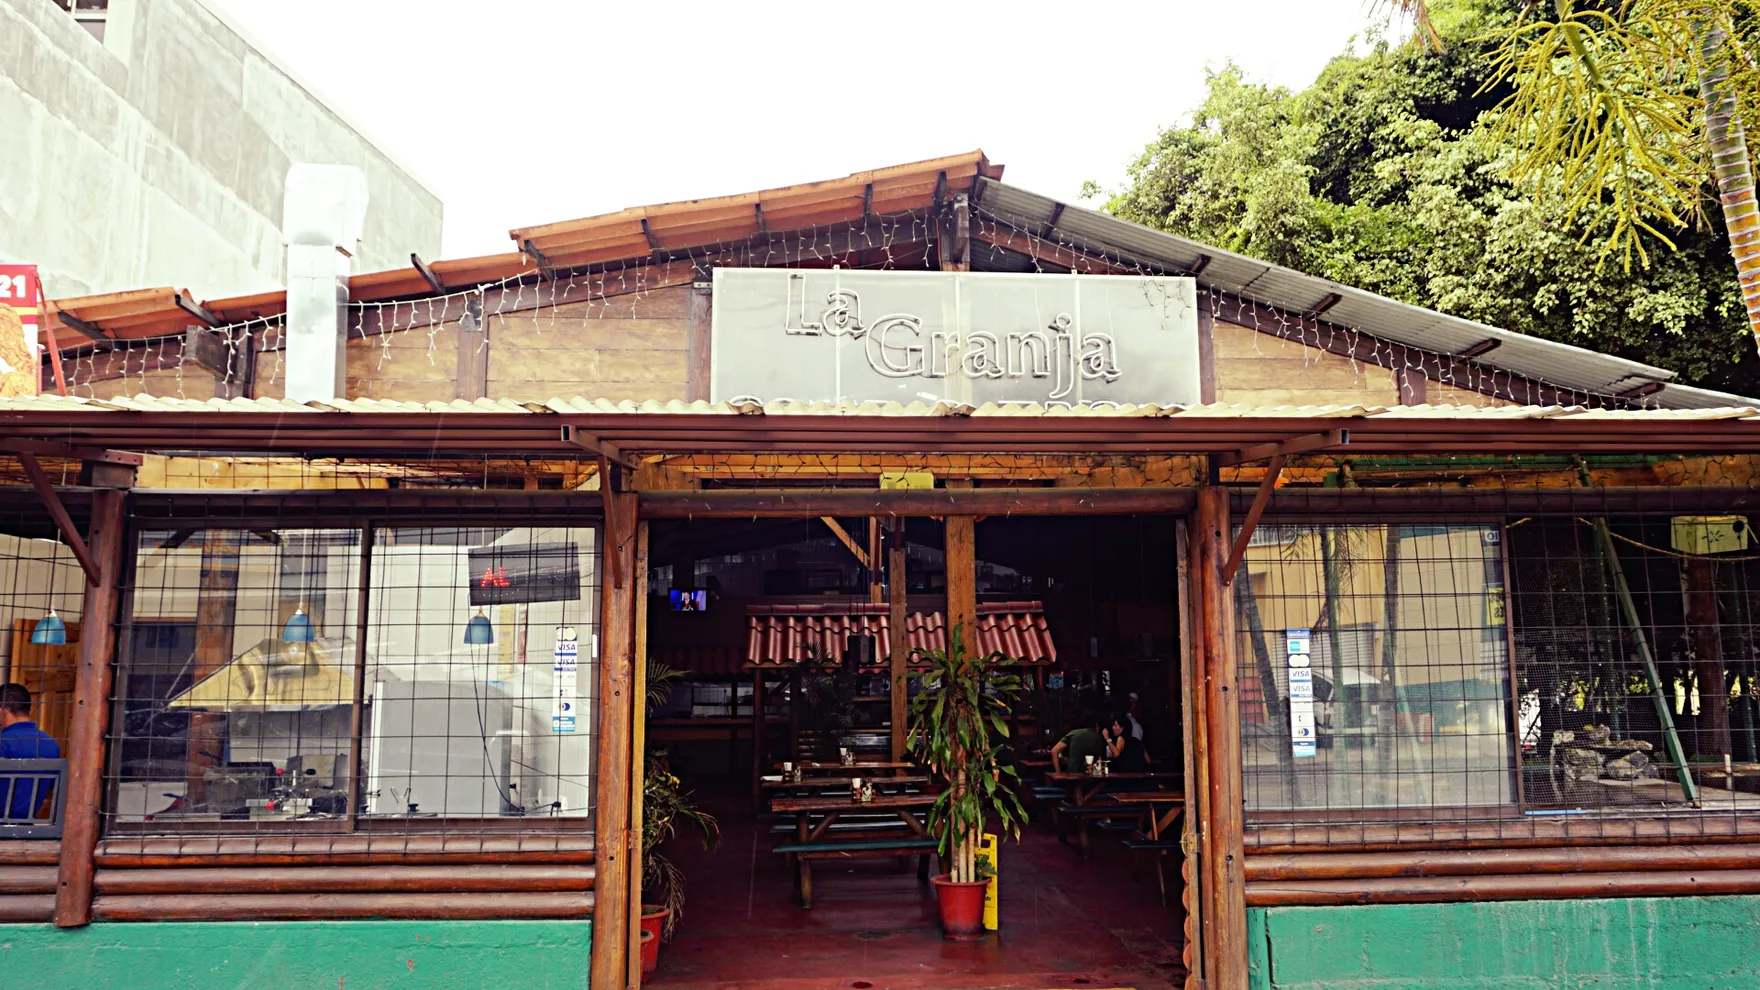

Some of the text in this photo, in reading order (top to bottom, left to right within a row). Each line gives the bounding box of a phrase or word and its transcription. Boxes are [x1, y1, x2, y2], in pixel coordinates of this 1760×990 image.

[786, 272, 1123, 399] La Granja
[557, 643, 577, 651] VISA
[556, 658, 576, 666] VISA
[1292, 670, 1310, 678] VISA
